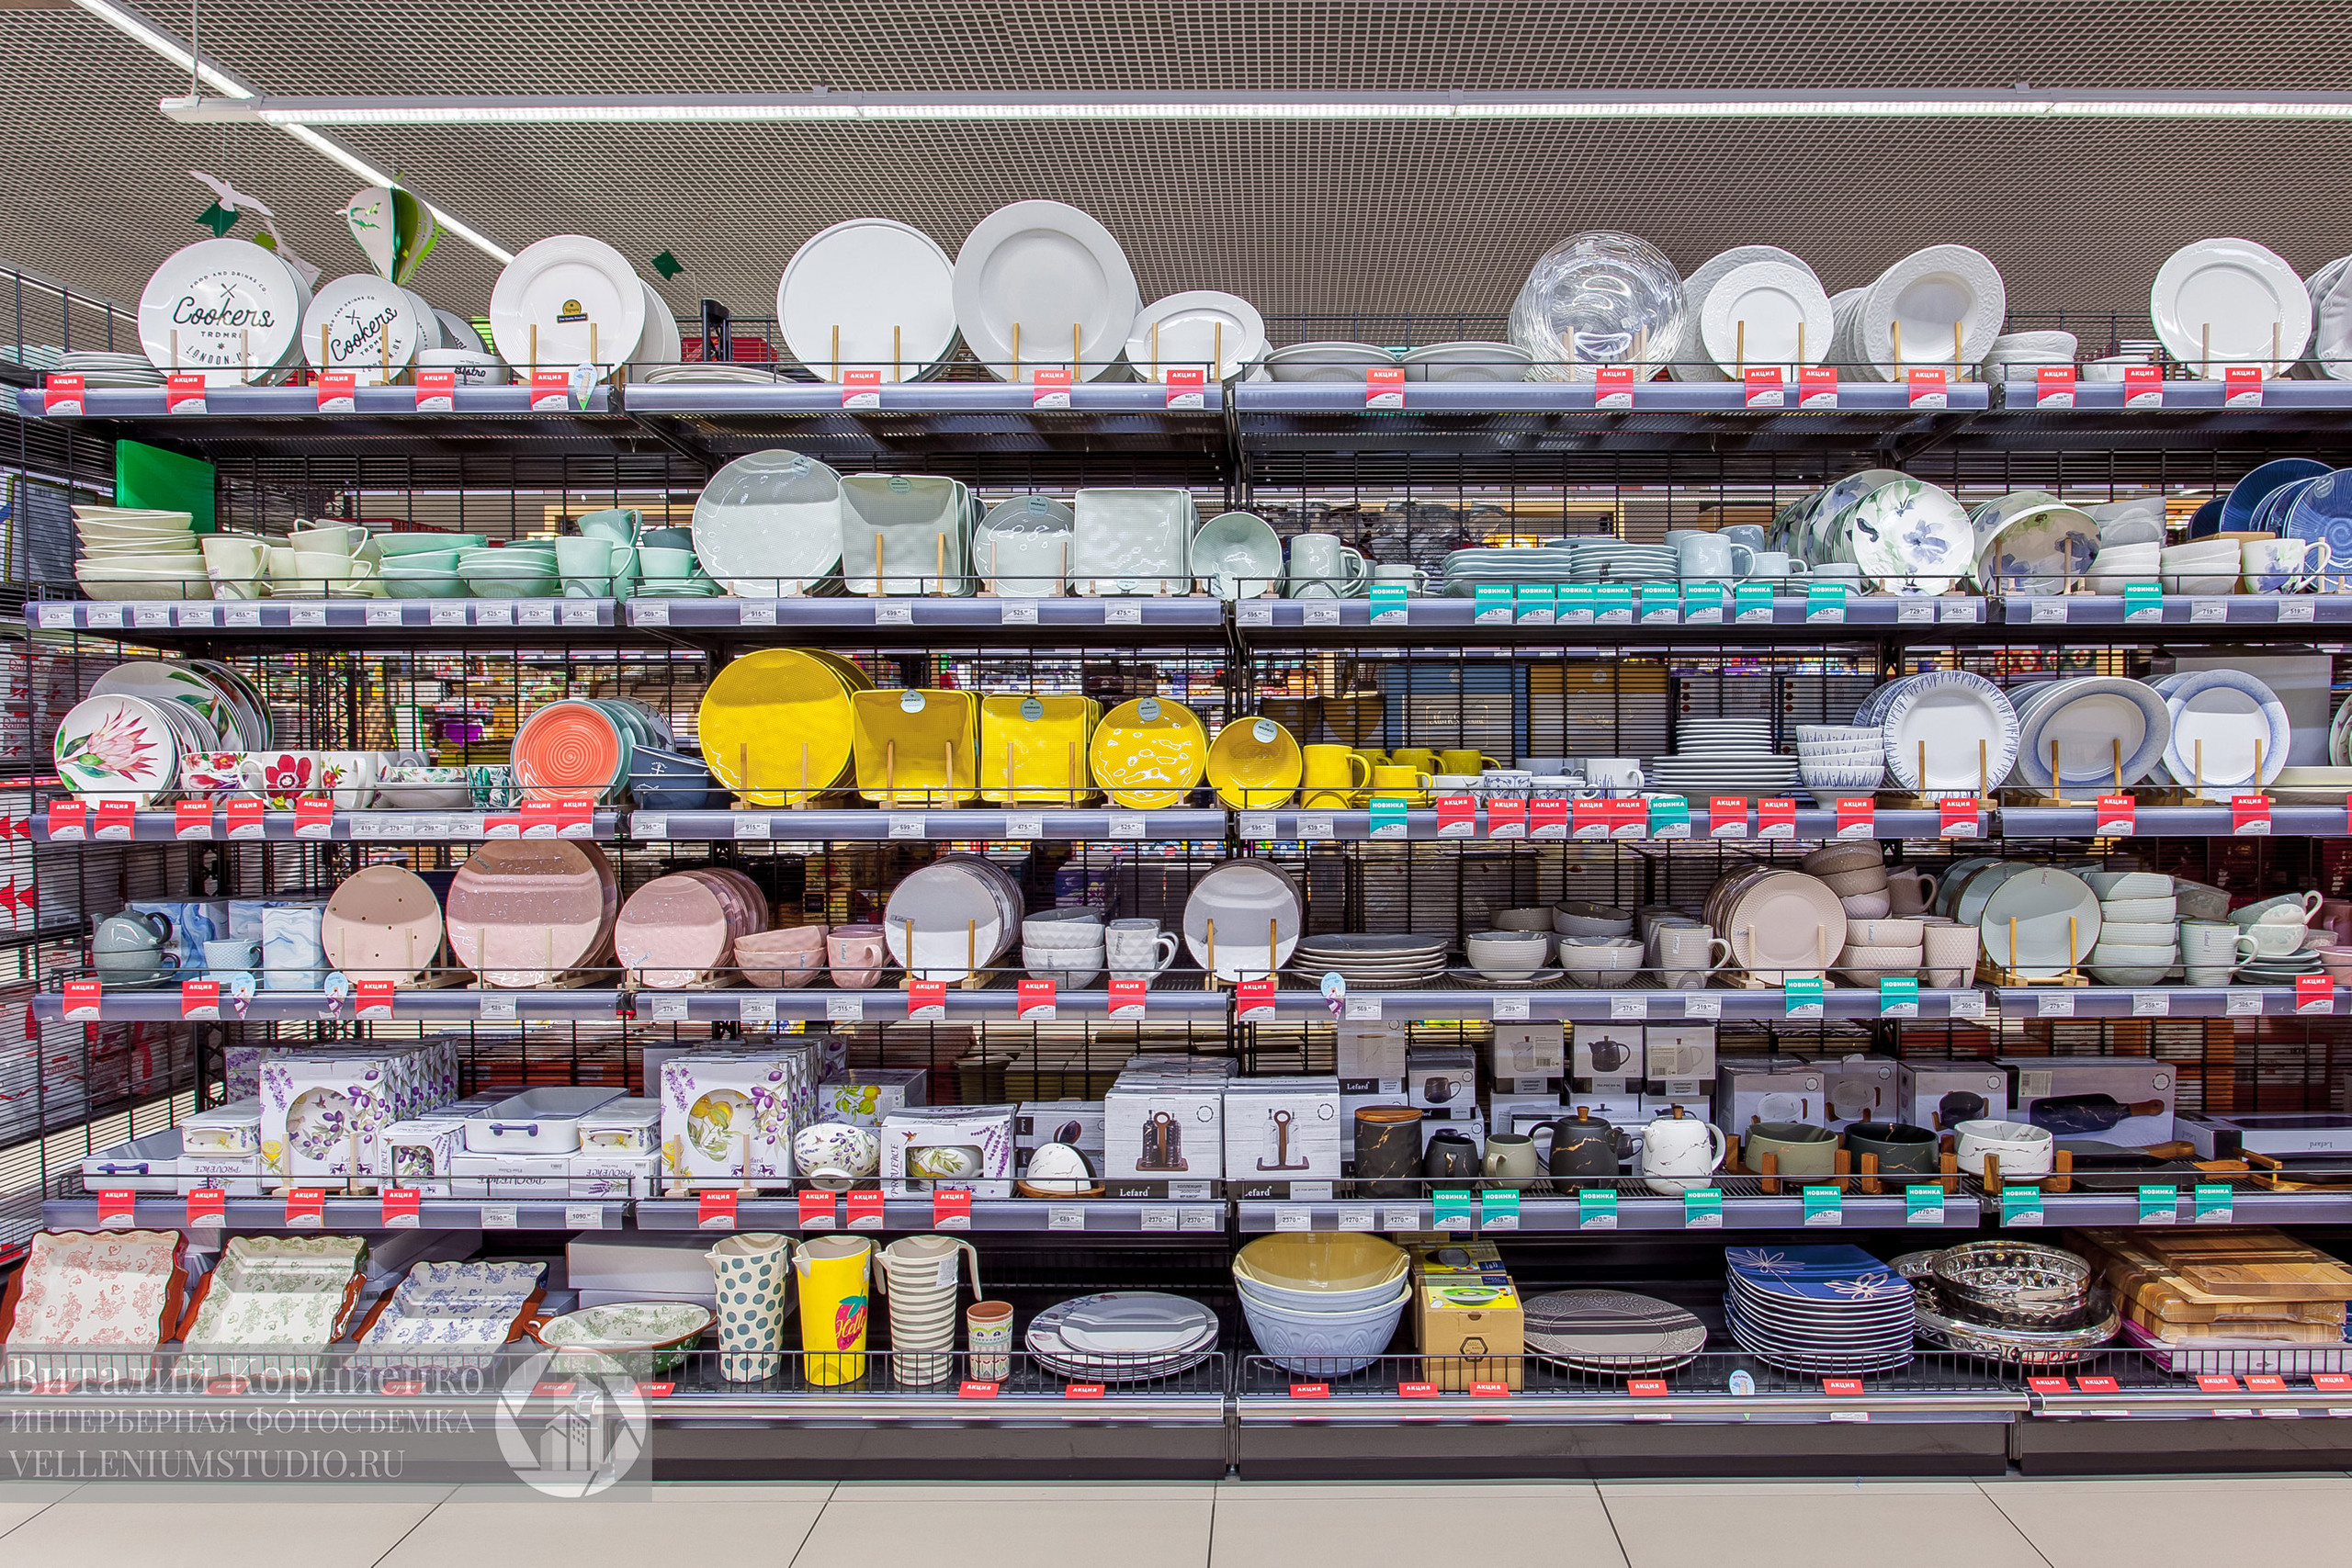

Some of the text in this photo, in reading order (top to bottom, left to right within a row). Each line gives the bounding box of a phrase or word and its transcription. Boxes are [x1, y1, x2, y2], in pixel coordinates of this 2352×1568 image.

[189, 275, 209, 289] FOOD
[231, 270, 258, 284] DRINKS
[173, 296, 276, 328] Cookers
[200, 331, 242, 339] TRDMR
[330, 306, 399, 362] Cookers
[454, 366, 486, 378] Bistro
[303, 800, 328, 808] АКЦИЯ
[1347, 1082, 1368, 1090] Lefard
[1119, 1187, 1148, 1197] Lefard
[1244, 1188, 1272, 1197] efard
